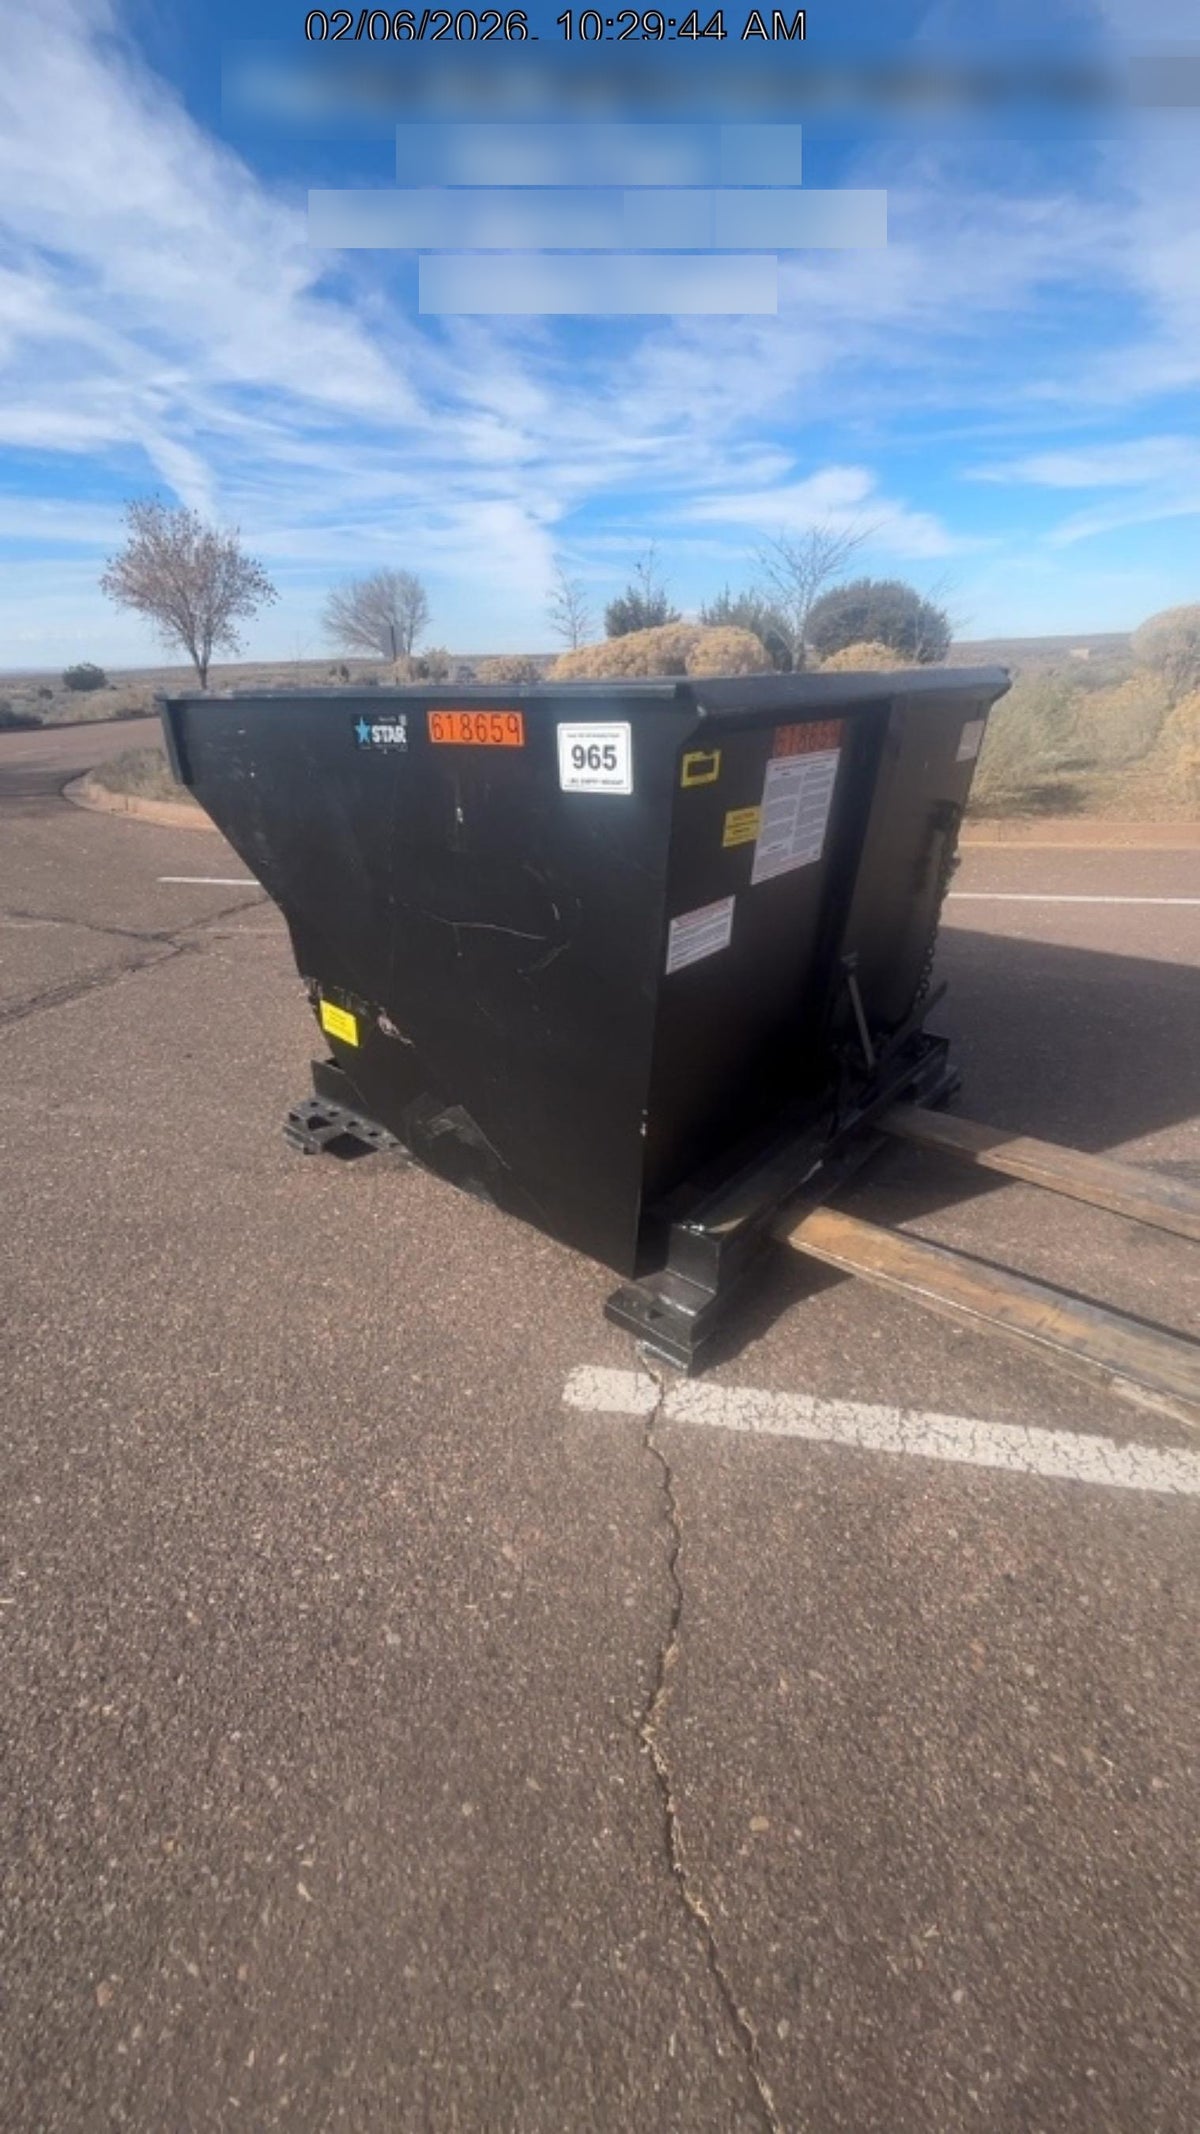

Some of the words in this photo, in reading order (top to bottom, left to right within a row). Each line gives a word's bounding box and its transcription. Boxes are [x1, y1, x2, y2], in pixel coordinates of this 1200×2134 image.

[372, 725, 406, 743] STAR
[431, 713, 520, 743] 618659
[571, 744, 617, 770] 965
